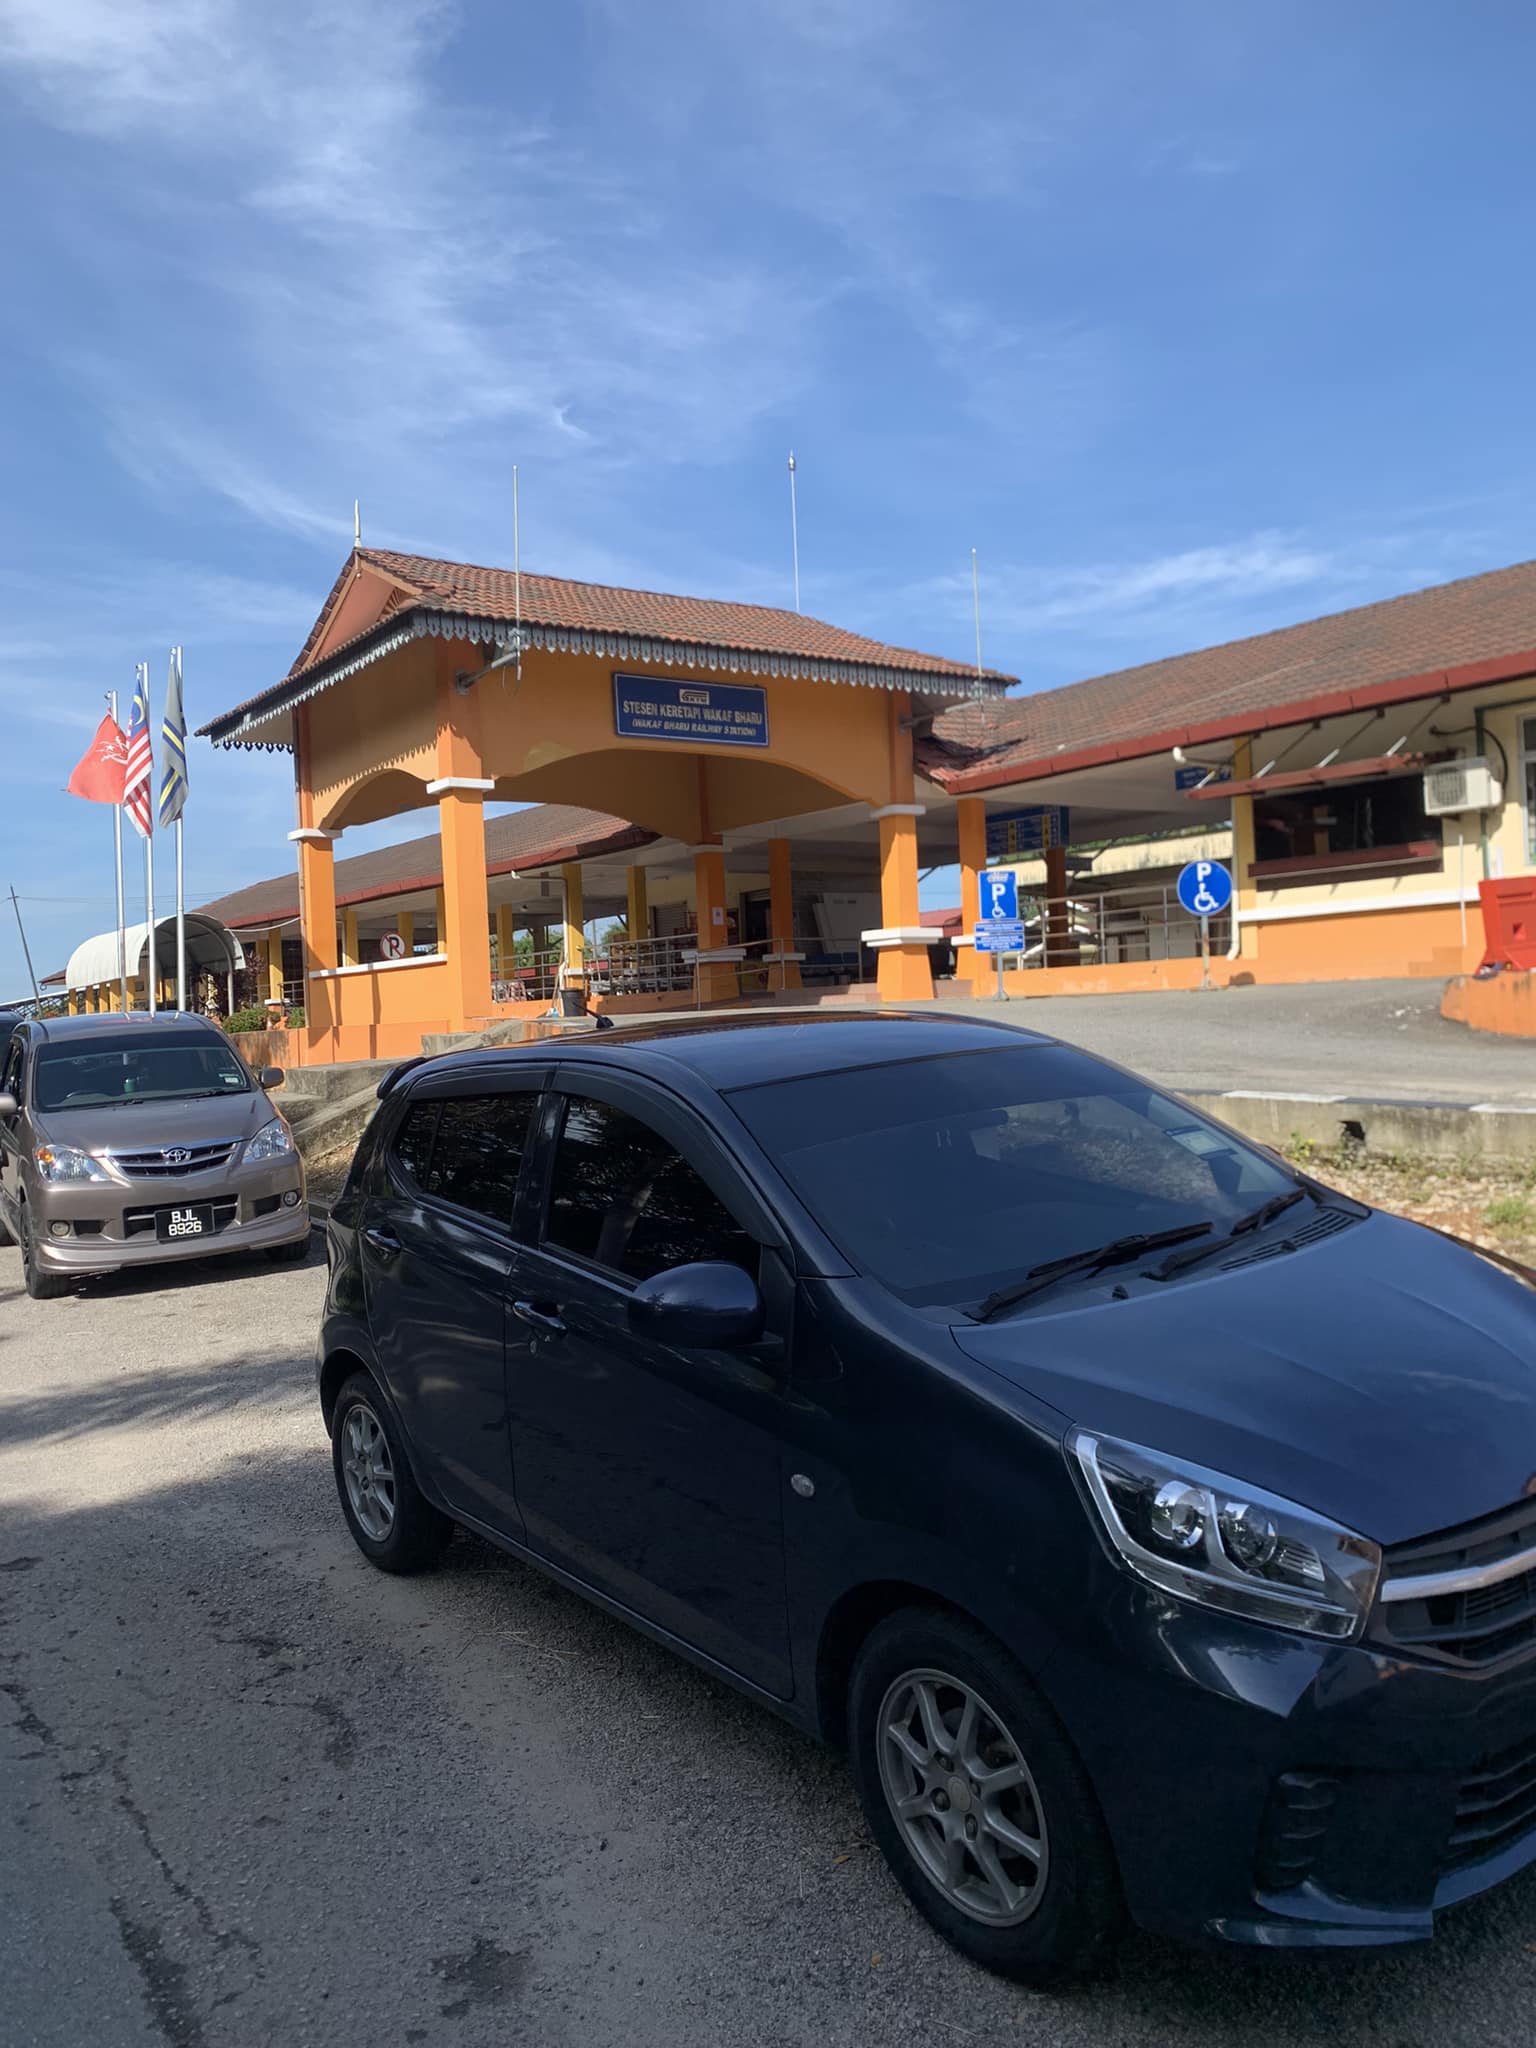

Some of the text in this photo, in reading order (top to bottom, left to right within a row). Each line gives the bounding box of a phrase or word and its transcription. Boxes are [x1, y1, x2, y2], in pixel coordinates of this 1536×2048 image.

[623, 701, 762, 724] STESEN KERETAPI WAKAF BHARU
[1197, 862, 1212, 882] P
[992, 883, 1006, 901] P
[171, 1209, 198, 1223] BJL
[168, 1220, 202, 1236] 8926
